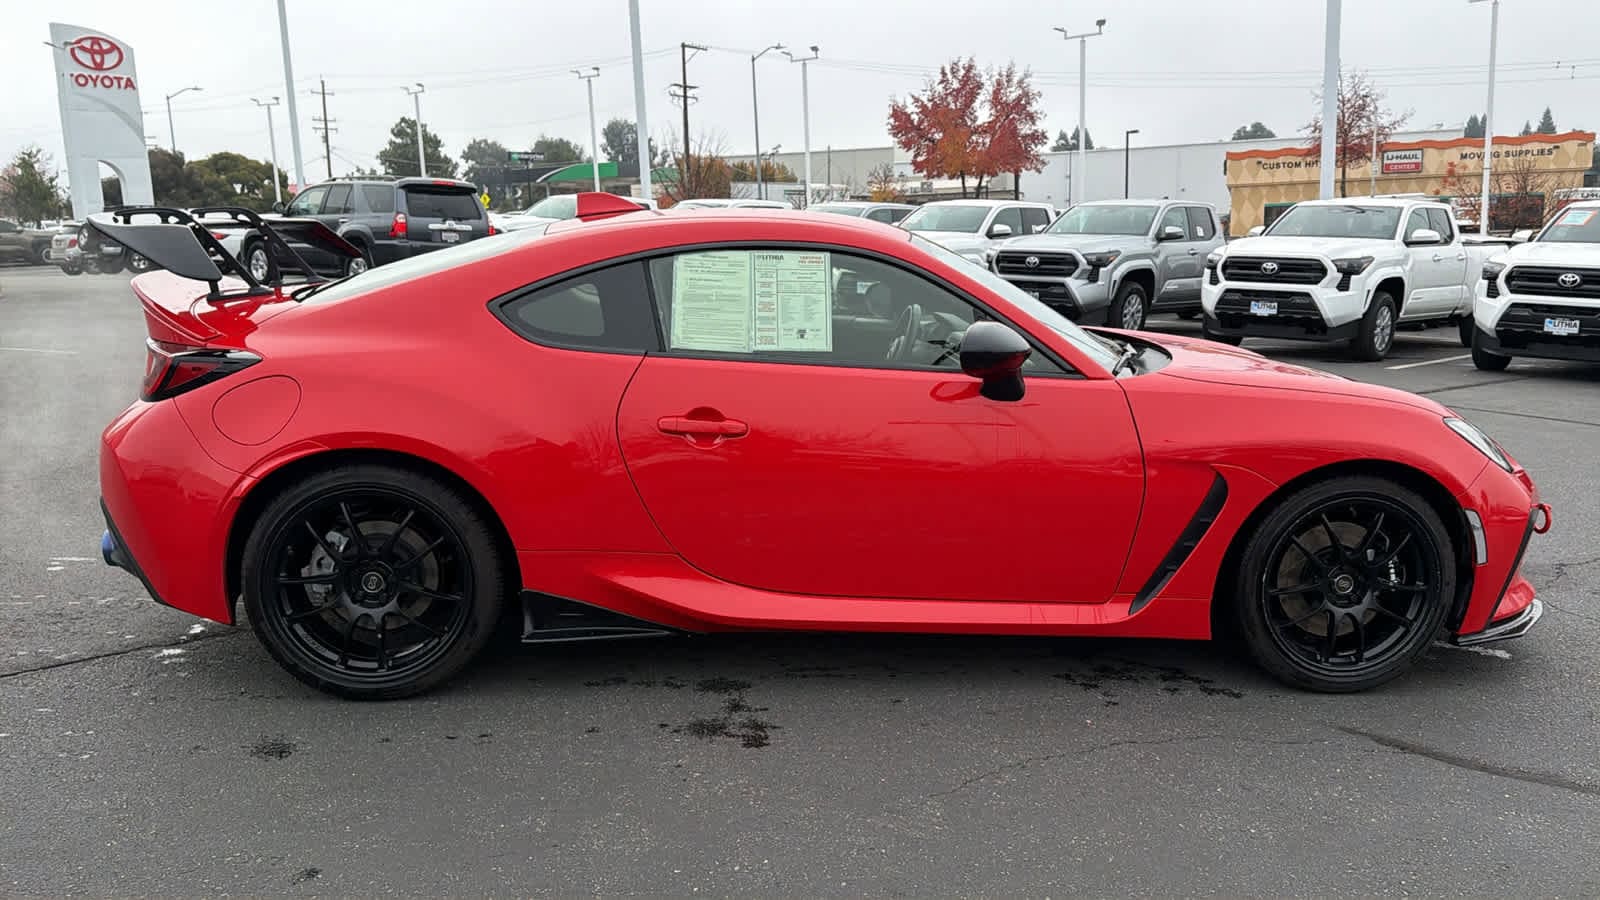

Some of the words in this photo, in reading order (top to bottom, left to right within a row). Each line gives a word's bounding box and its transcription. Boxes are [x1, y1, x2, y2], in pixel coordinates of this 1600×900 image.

[69, 73, 136, 90] OYOTA
[1386, 153, 1420, 161] U-HAUL
[1553, 321, 1578, 329] LITHIA
